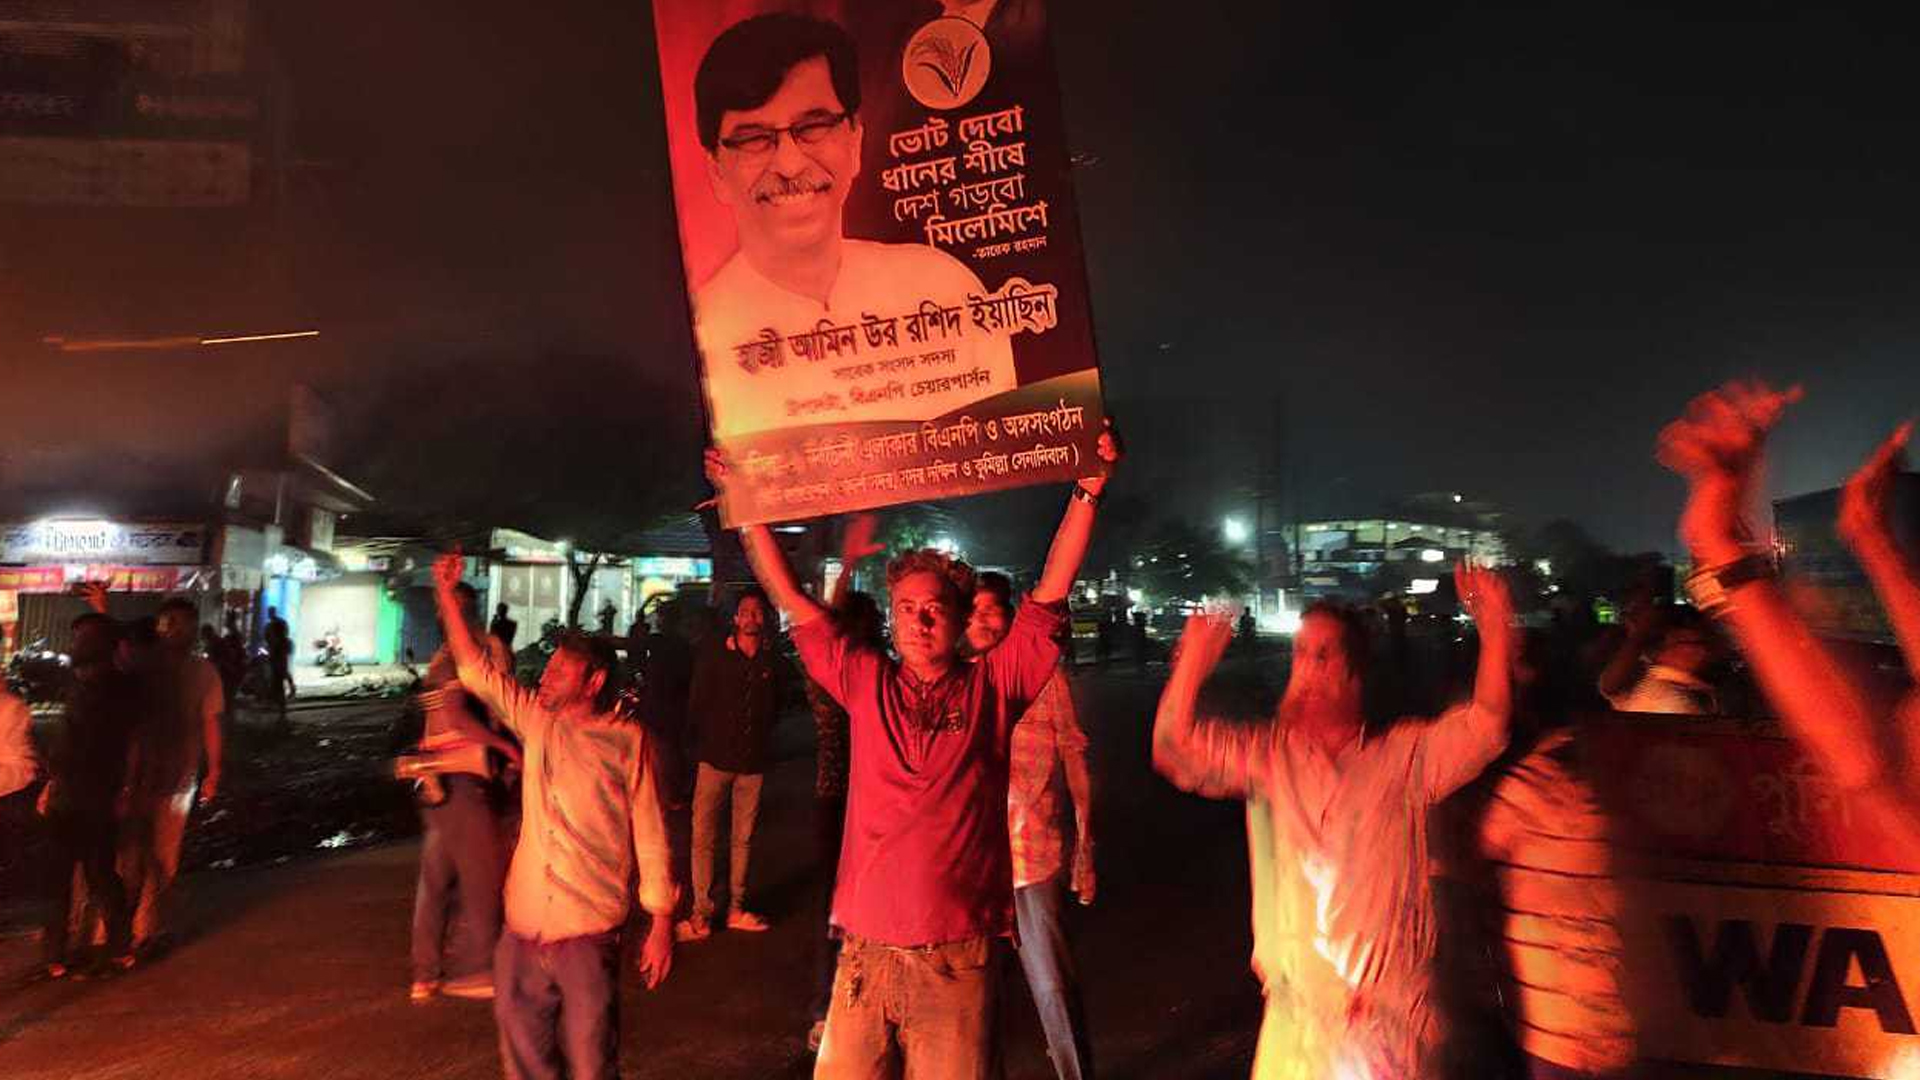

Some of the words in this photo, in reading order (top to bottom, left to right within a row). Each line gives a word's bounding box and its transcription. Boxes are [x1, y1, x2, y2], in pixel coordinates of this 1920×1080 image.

[889, 118, 949, 157] ভোট
[959, 105, 1024, 143] দেবো
[881, 156, 957, 192] ধানের
[963, 140, 1025, 174] শীষে
[894, 189, 940, 222] দেশ
[949, 174, 1025, 210] গড়বো
[924, 200, 1048, 247] মিলেমিশে
[1014, 236, 1048, 253] রহমান
[788, 319, 858, 361] আমিন
[860, 311, 898, 348] উর
[902, 299, 963, 343] রশিদ
[967, 284, 1052, 335] ইয়াছিন
[920, 415, 980, 451] বিএনপি
[984, 419, 999, 441] ও
[1001, 399, 1084, 438] অঙ্গসংগঠন
[961, 463, 972, 477] ও
[1012, 443, 1069, 470] সেনানিবাস
[1667, 913, 1918, 1035] WA
